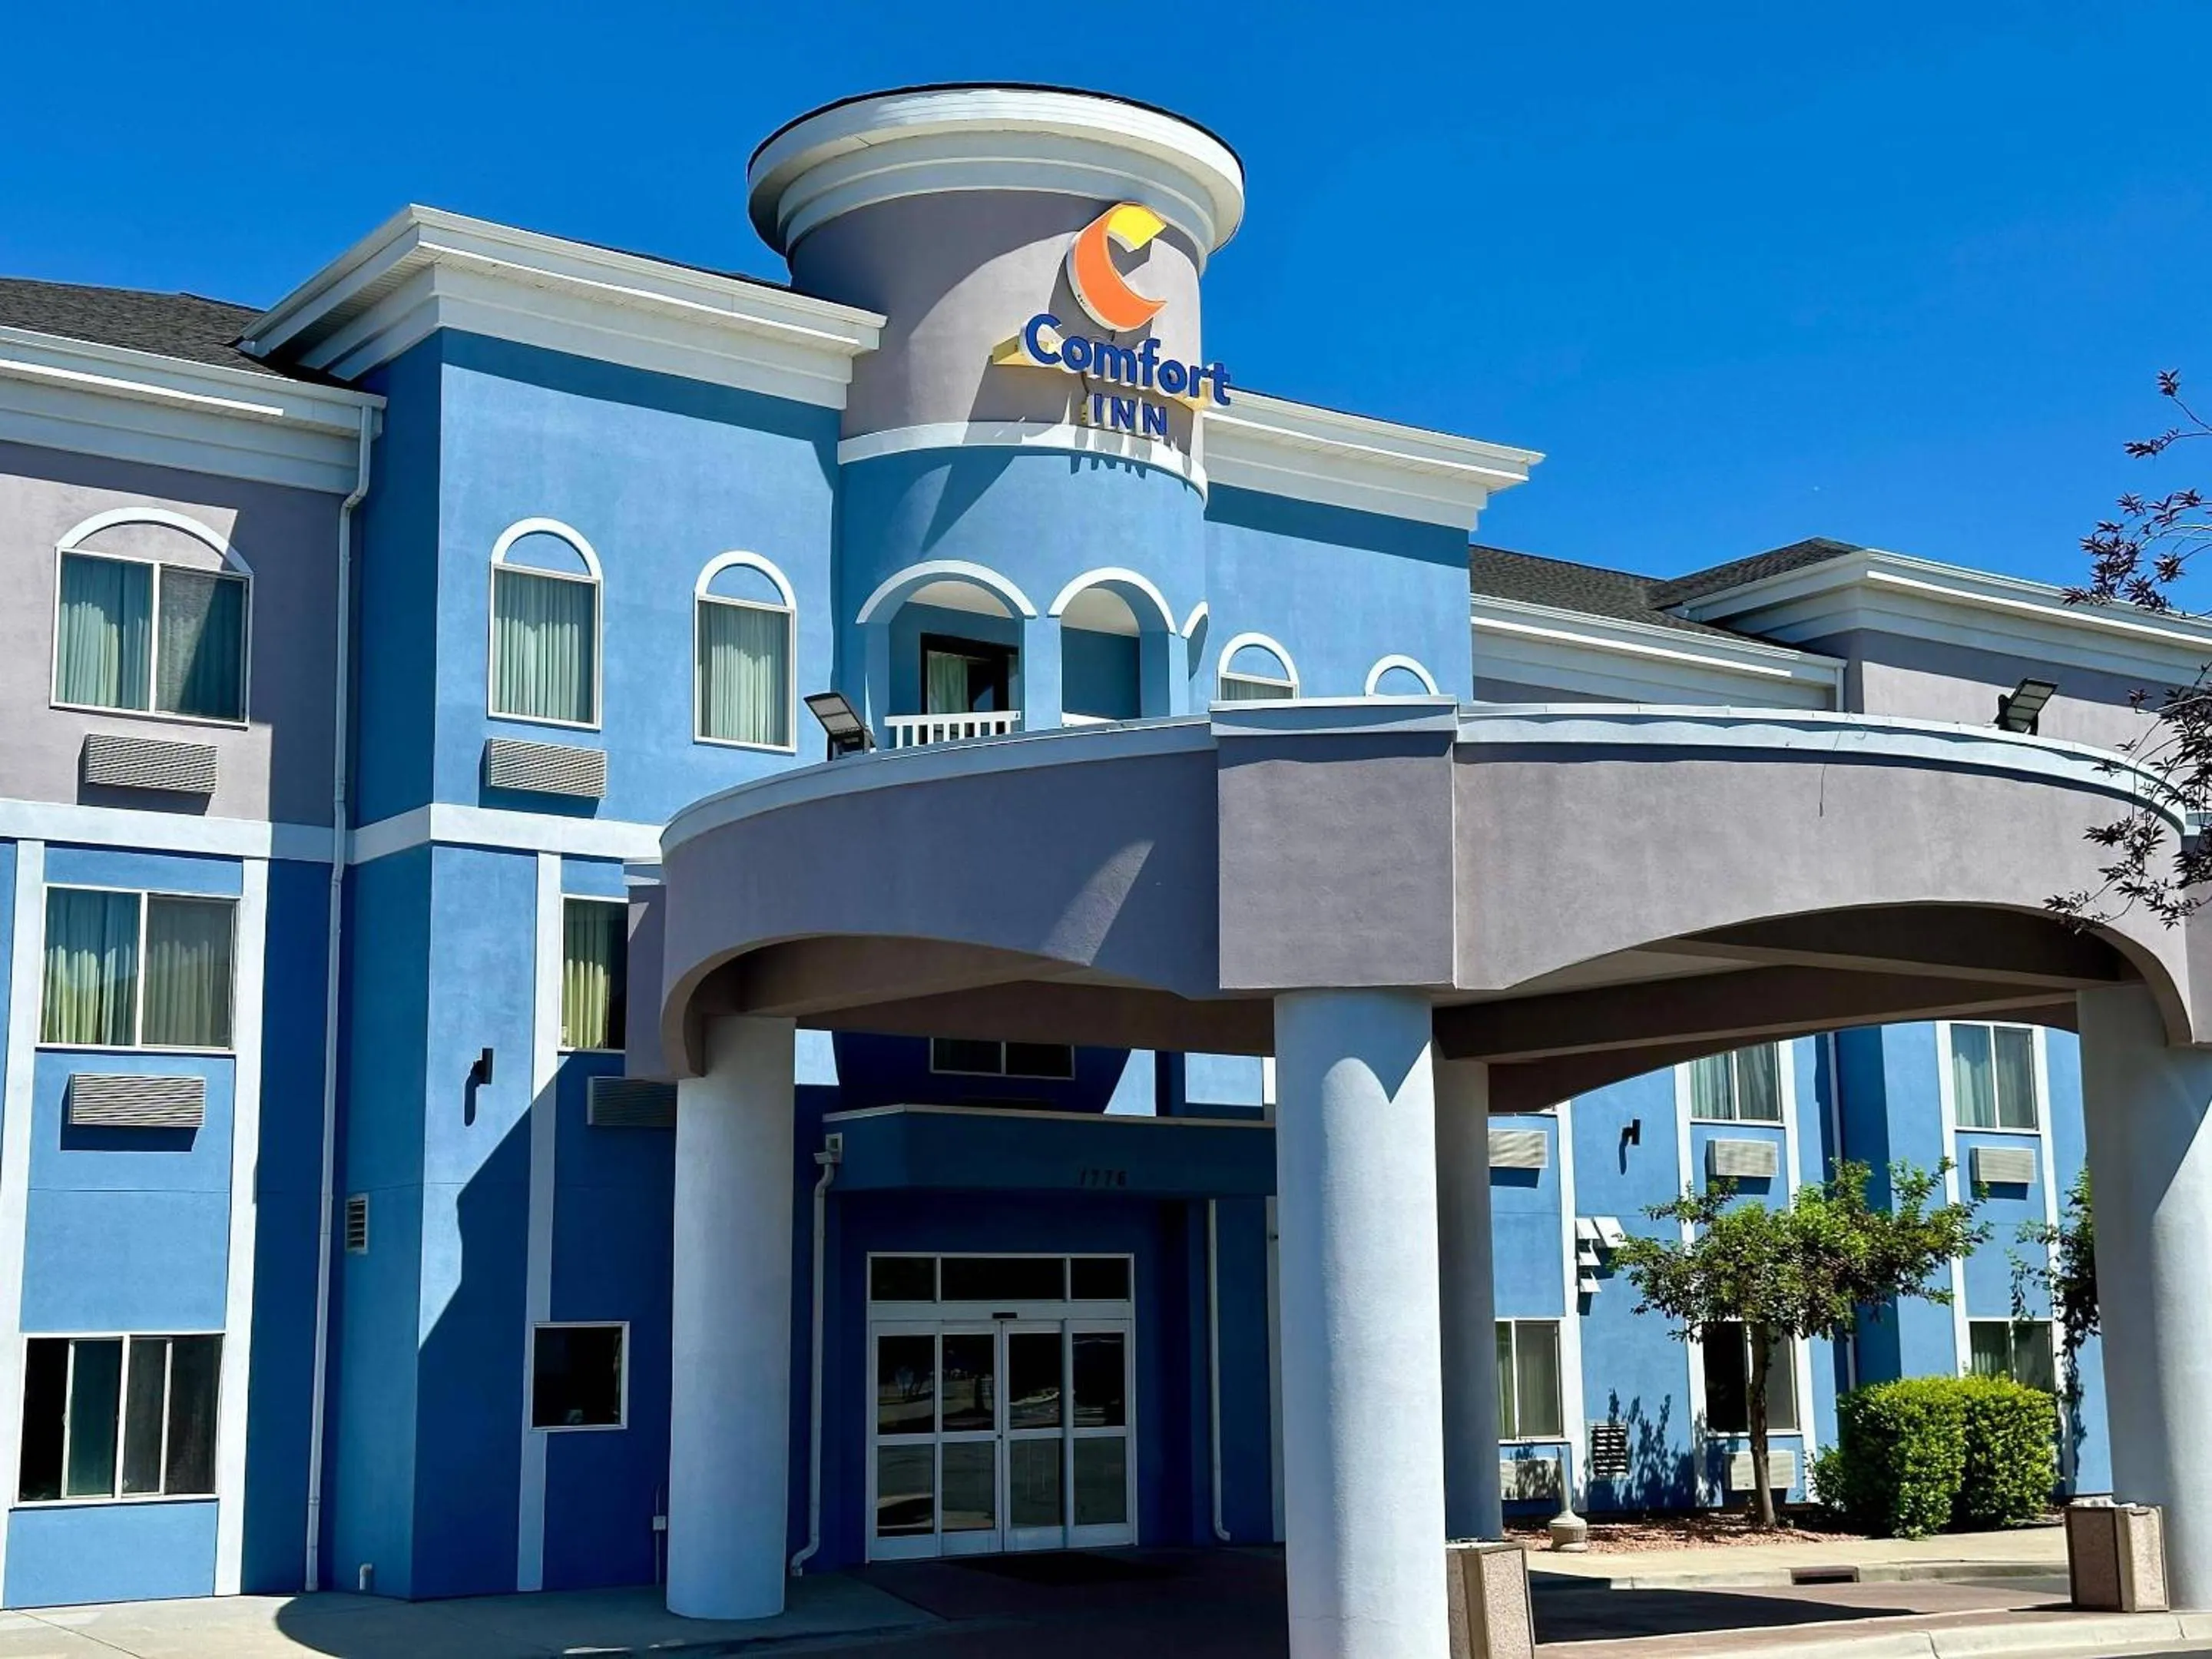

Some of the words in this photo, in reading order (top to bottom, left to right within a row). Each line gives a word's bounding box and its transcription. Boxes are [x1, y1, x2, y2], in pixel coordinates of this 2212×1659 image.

[1024, 313, 1231, 406] Comfort
[1092, 392, 1167, 436] INN
[1078, 1166, 1128, 1187] 1776
